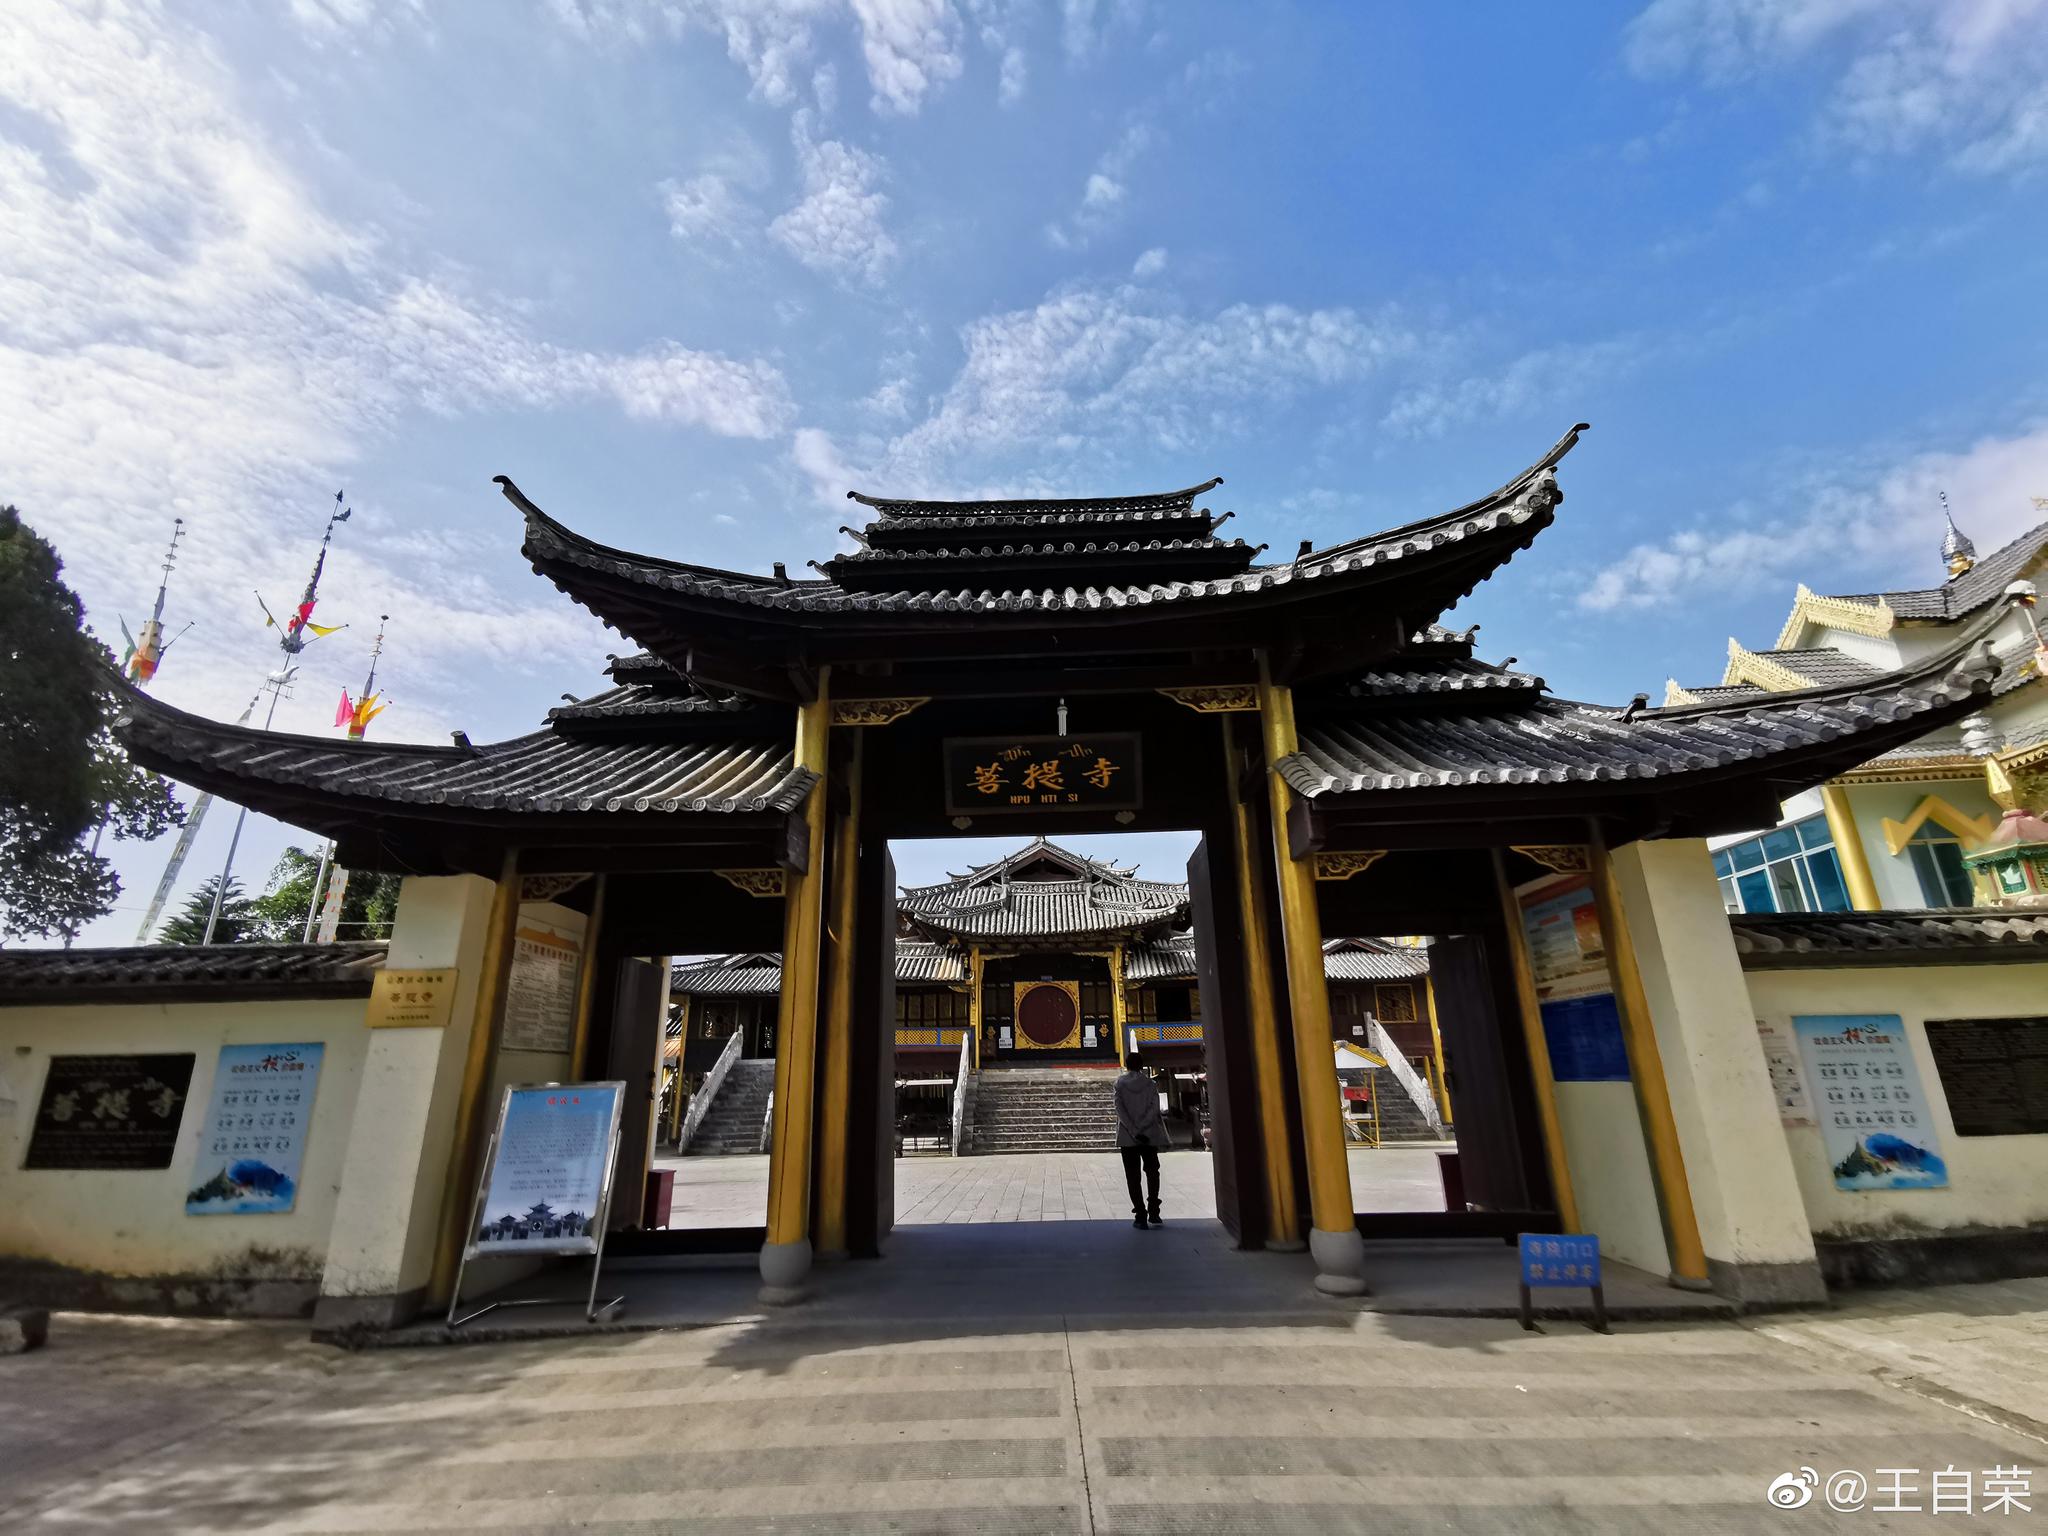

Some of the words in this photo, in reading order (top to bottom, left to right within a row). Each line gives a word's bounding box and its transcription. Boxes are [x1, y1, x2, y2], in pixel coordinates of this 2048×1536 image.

[966, 757, 1121, 795] 菩提寺
[1010, 795, 1030, 804] HPU
[1040, 794, 1058, 803] HTI
[1067, 793, 1079, 803] SI
